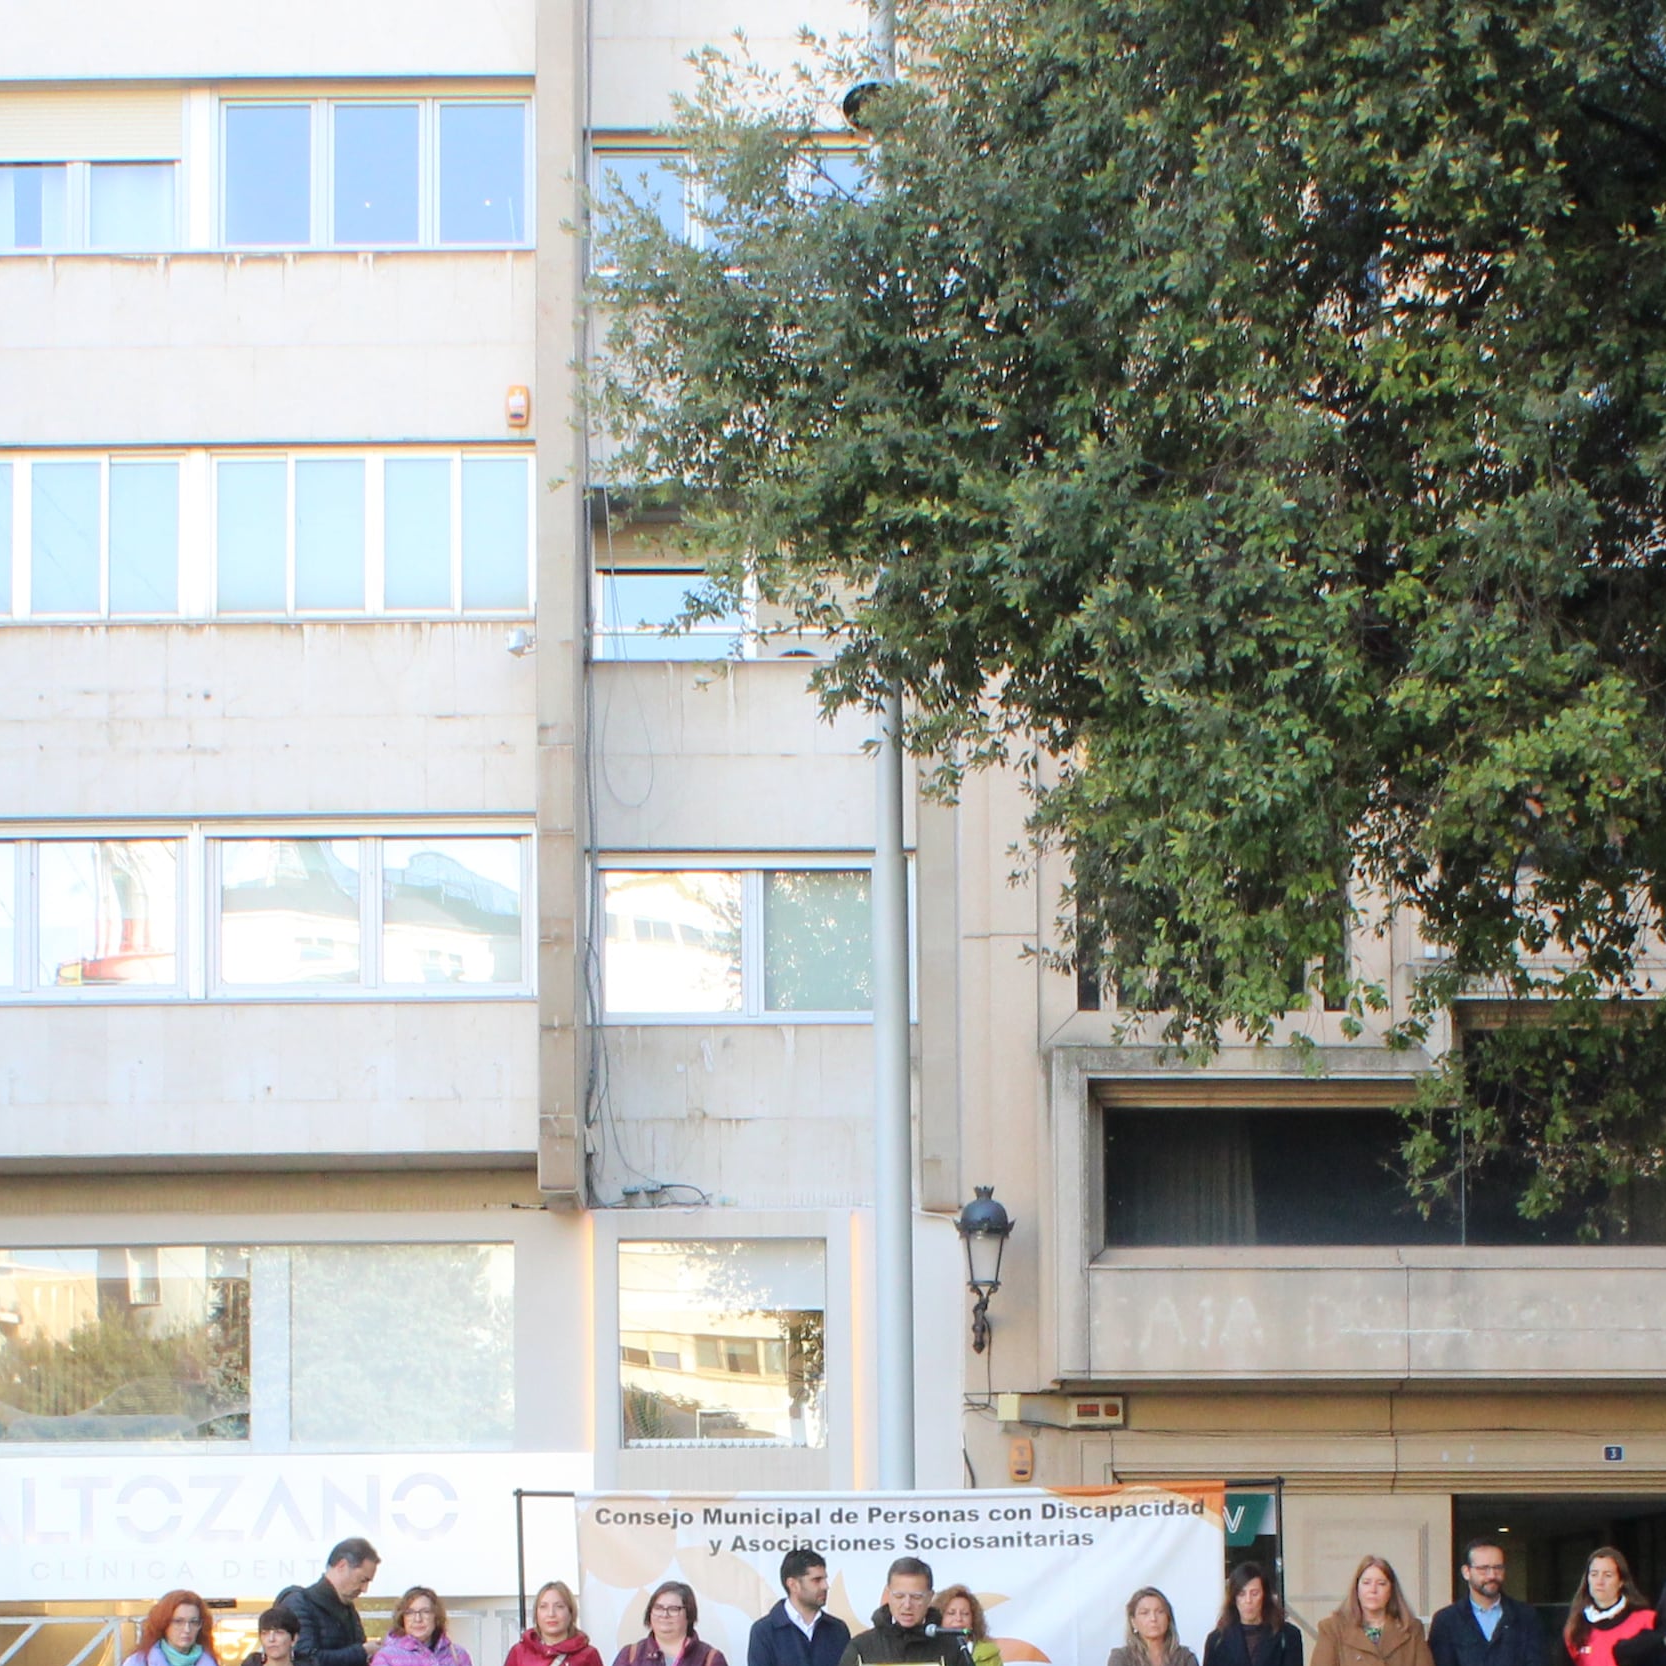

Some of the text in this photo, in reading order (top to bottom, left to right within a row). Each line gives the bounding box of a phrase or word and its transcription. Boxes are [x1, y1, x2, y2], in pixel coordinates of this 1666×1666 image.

[595, 1499, 1205, 1529] Consejo Municipal de Personas con Discapacidad
[708, 1531, 1094, 1556] y Asociaciones Sociosanitarias
[29, 1556, 327, 1582] CLÍNICA DENT
